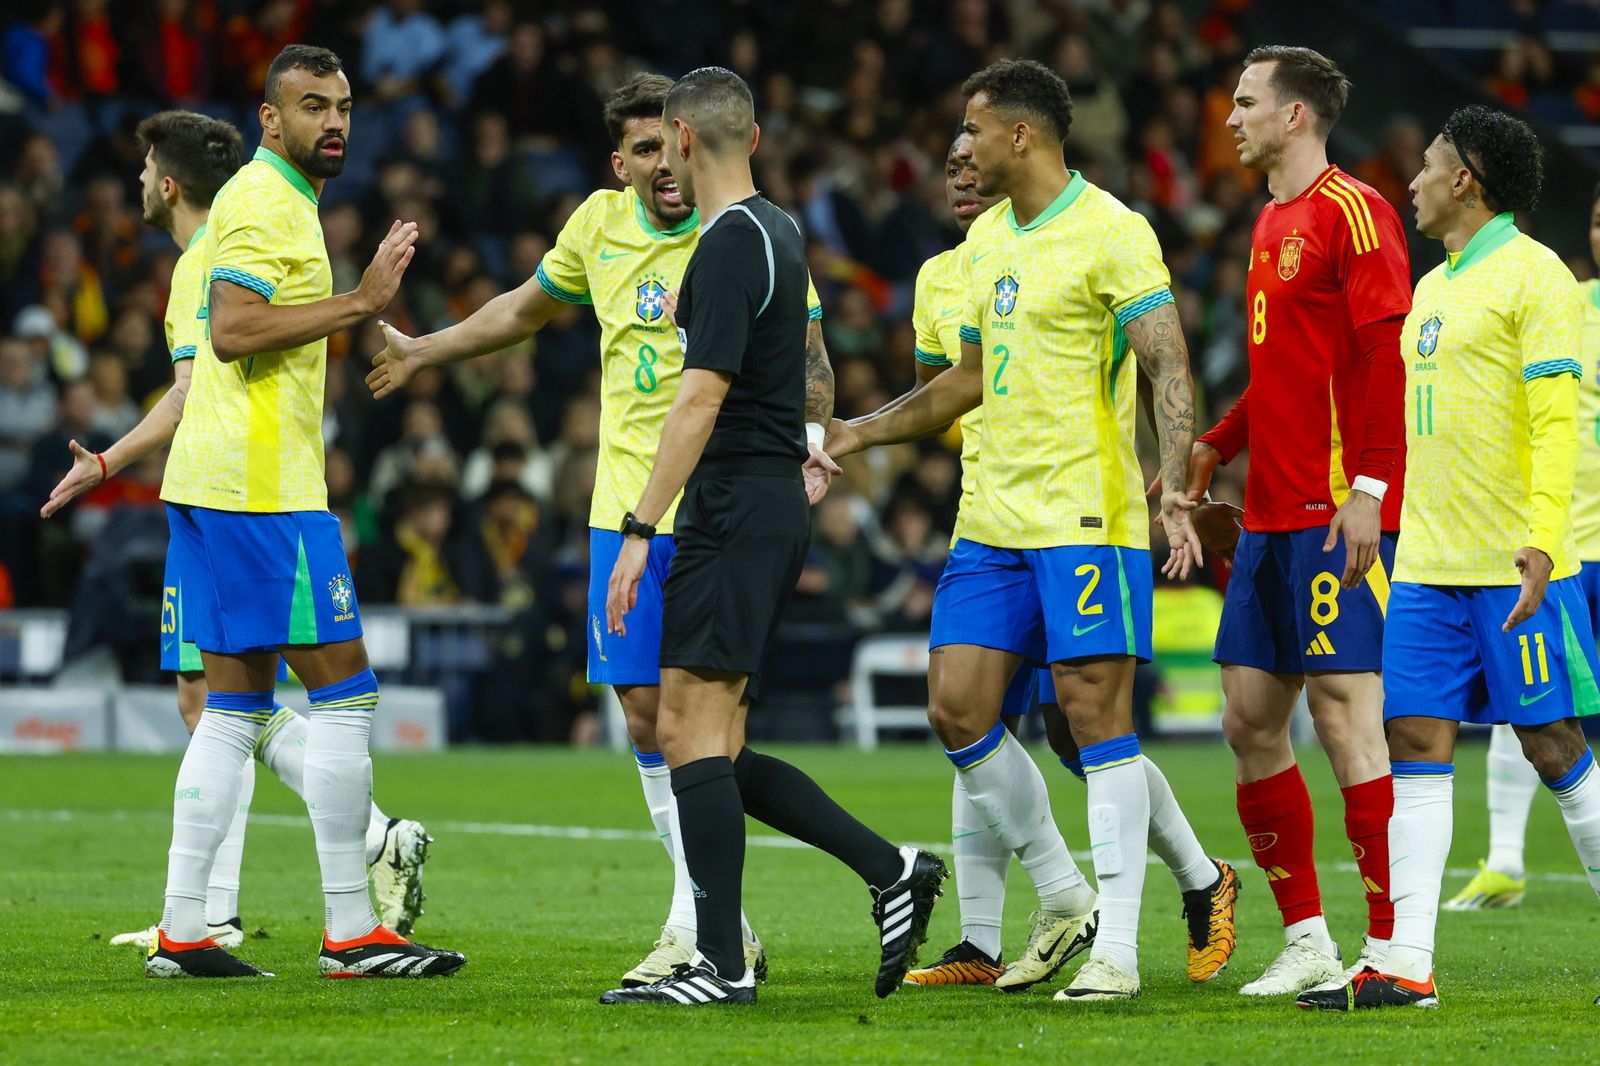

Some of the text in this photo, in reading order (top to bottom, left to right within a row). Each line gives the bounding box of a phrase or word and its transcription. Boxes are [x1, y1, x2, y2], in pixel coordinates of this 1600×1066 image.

[631, 323, 665, 333] BRASIL
[991, 321, 1016, 330] BRASIL
[1253, 290, 1266, 345] 8
[634, 344, 657, 393] 8
[993, 344, 1009, 395] 2
[1415, 362, 1438, 371] BRASIL
[1416, 384, 1433, 436] 11
[1074, 563, 1103, 616] 2
[1310, 571, 1340, 626] 8
[334, 612, 355, 622] BRASIL
[1518, 632, 1550, 685] 11
[175, 787, 204, 801] RASIL
